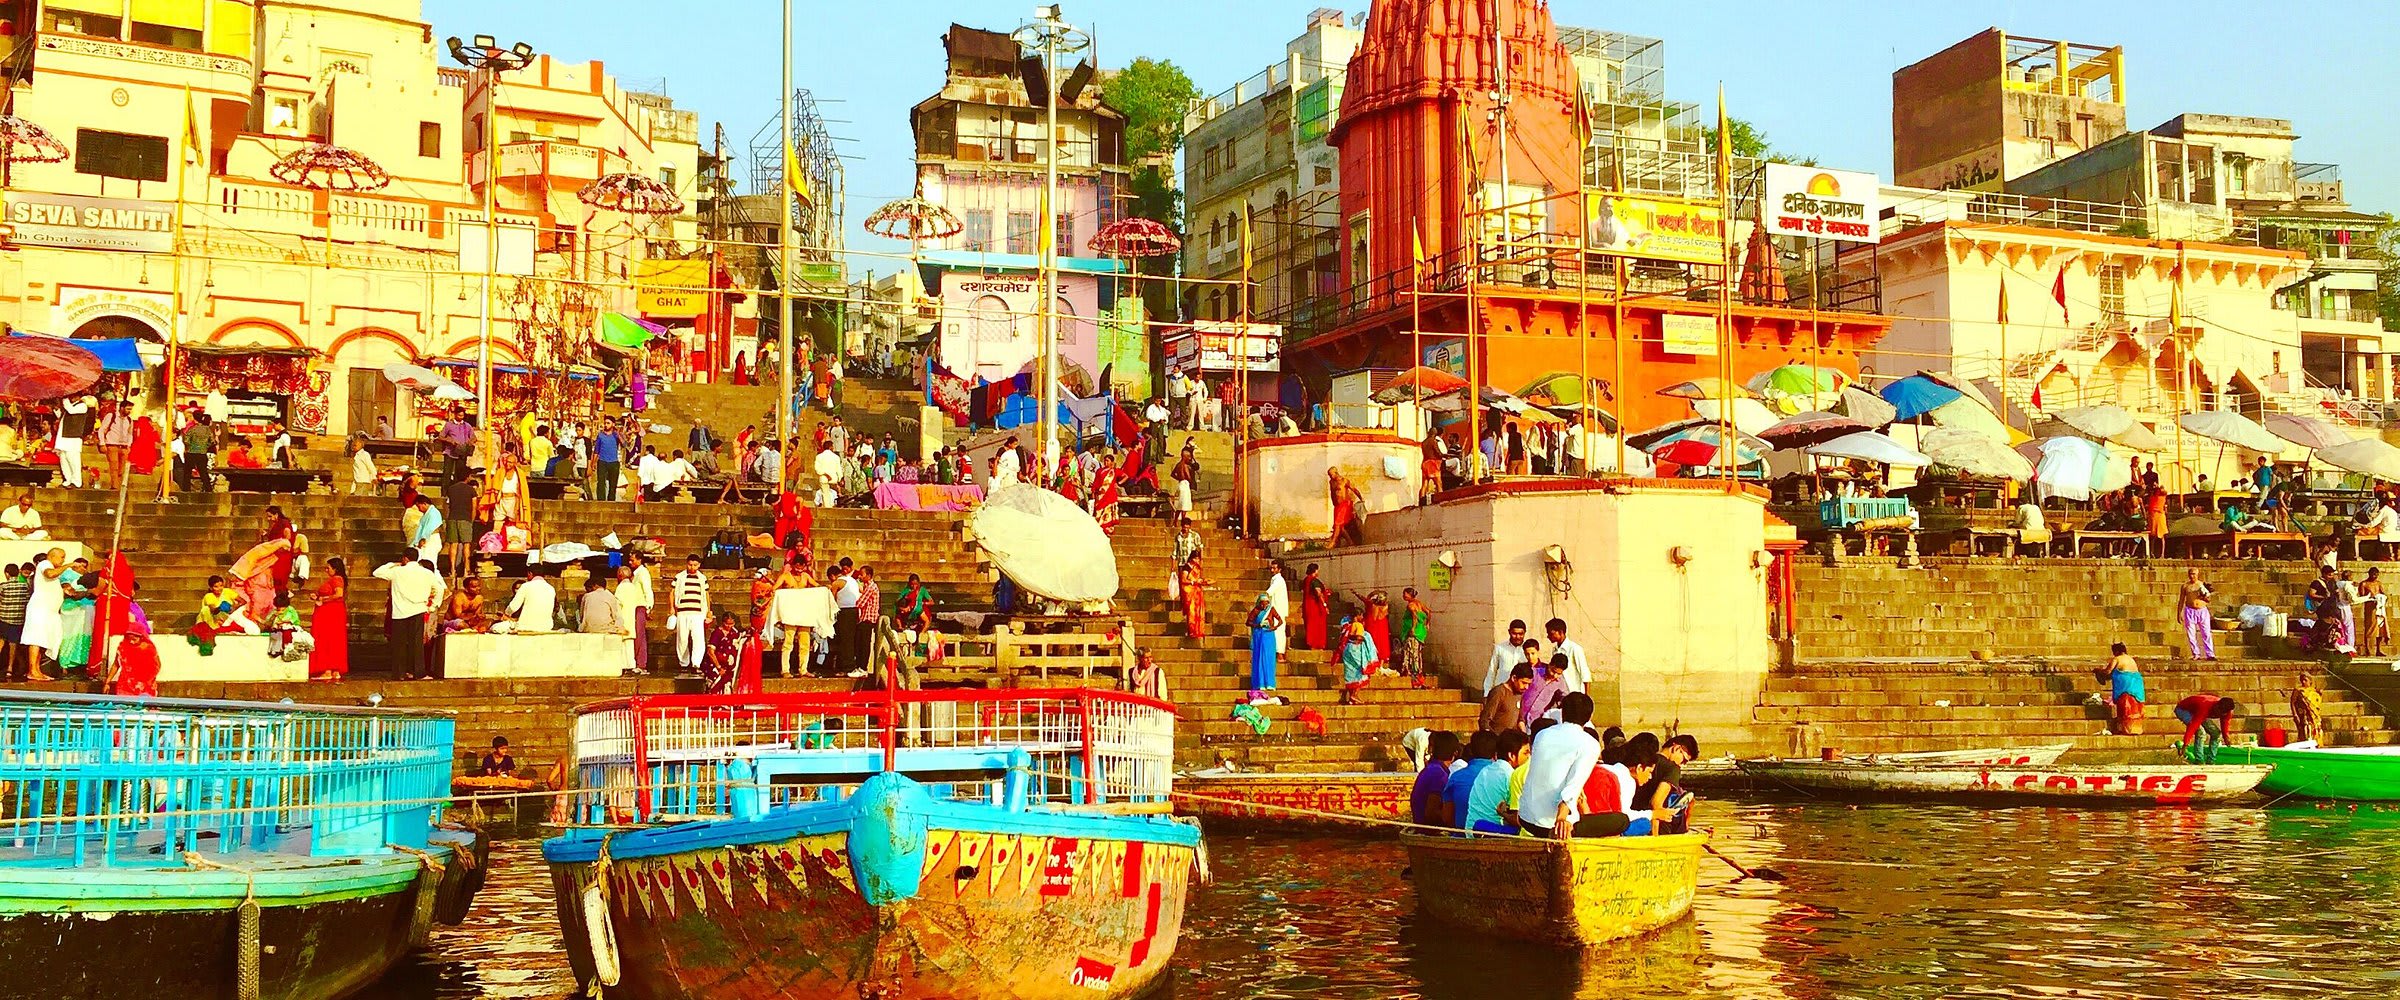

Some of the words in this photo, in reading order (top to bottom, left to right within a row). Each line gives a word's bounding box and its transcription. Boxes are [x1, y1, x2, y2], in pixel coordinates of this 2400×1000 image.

[14, 202, 78, 227] SEVA
[83, 206, 173, 232] SAMITI
[1783, 192, 1819, 215] दैनिक
[1820, 200, 1865, 219] जागरण
[1806, 215, 1824, 234] रहे
[657, 297, 688, 307] GHAT
